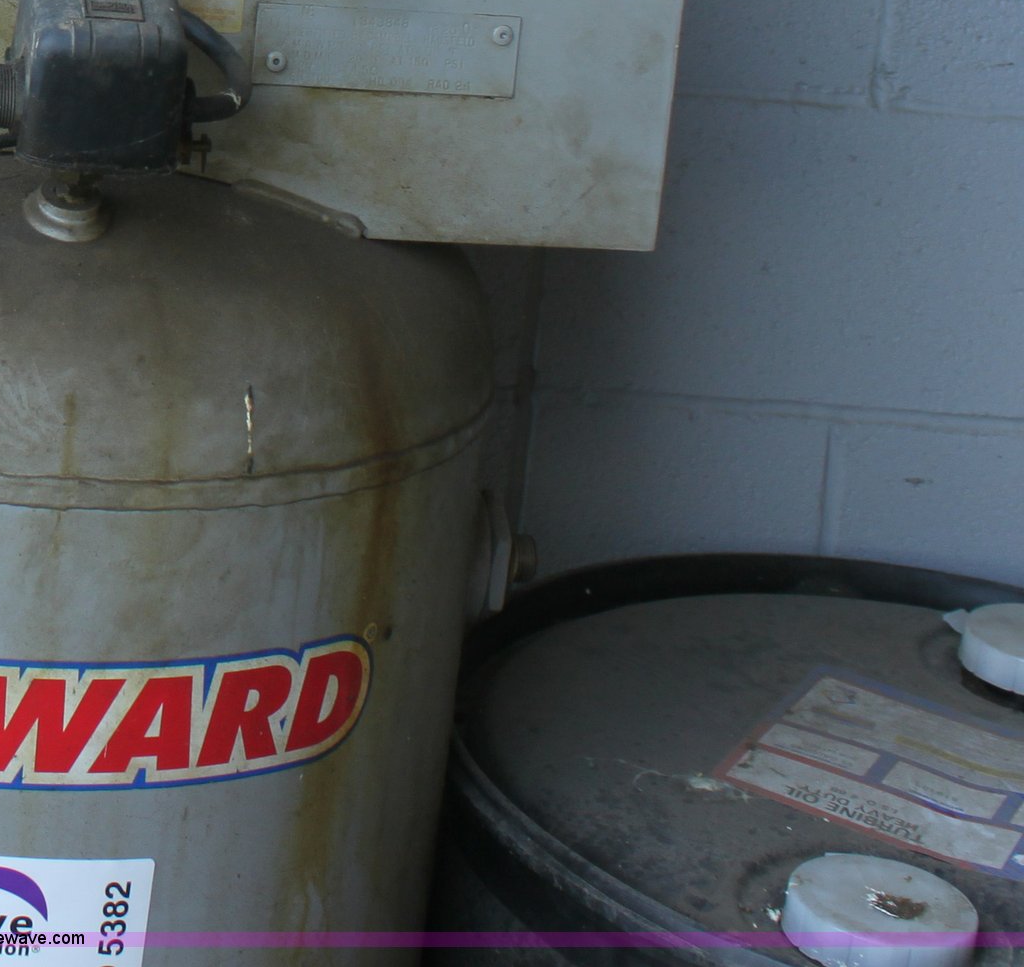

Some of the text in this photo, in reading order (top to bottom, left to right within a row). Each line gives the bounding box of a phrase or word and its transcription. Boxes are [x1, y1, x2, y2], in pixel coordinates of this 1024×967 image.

[784, 784, 820, 805] OIL
[797, 784, 920, 832] HEAVY DUTY
[824, 800, 927, 845] TURBINE
[98, 880, 133, 957] 5382
